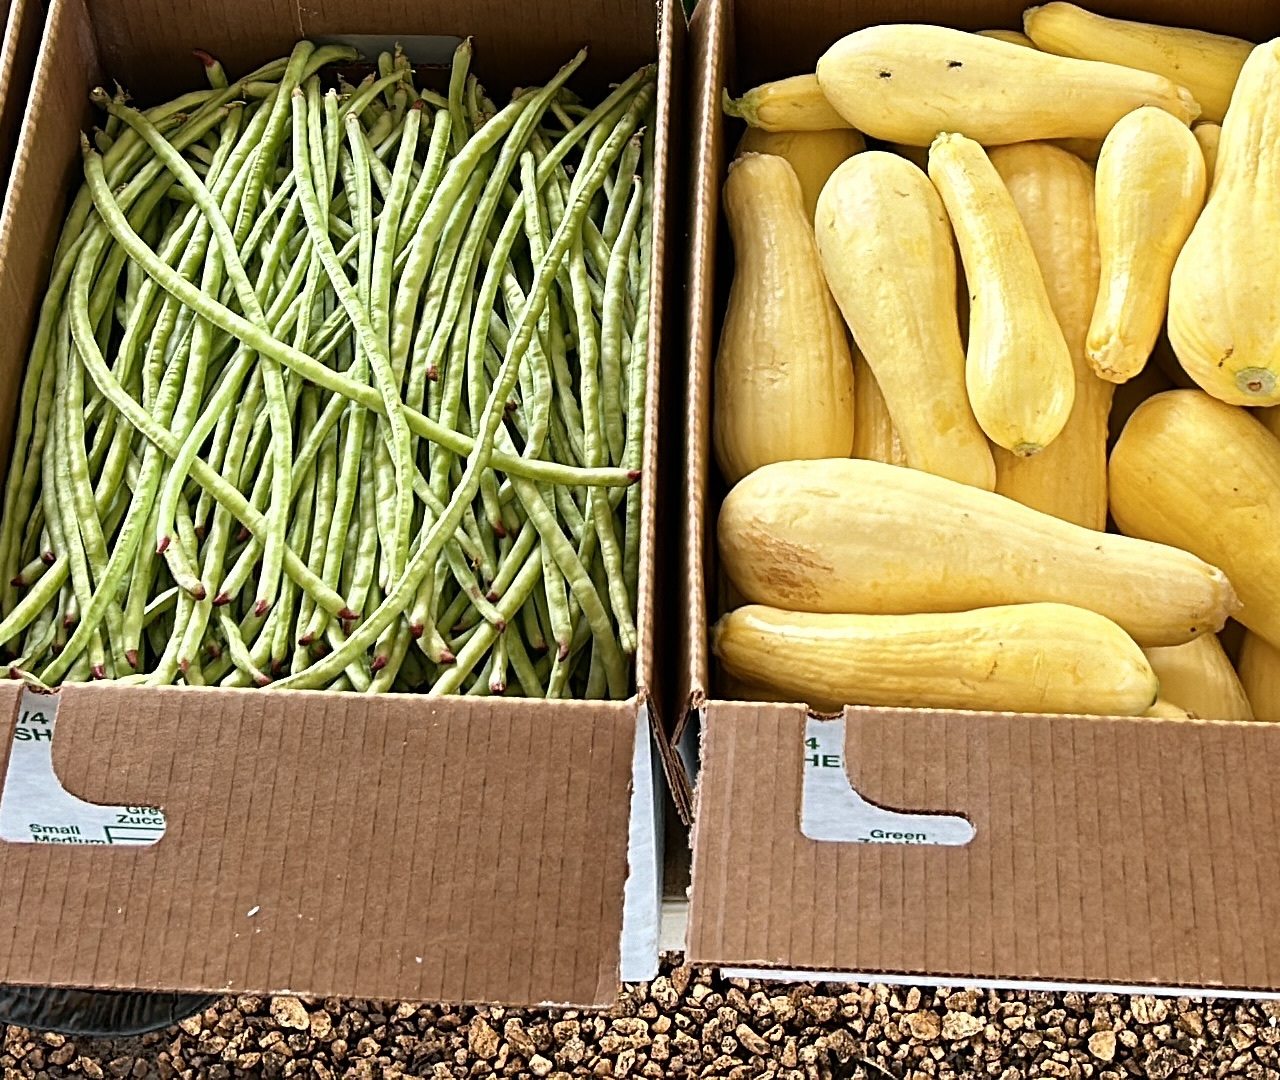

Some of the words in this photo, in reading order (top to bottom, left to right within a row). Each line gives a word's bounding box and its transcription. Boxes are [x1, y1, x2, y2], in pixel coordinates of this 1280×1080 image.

[805, 754, 844, 768] HE
[125, 806, 162, 816] Gre
[116, 814, 166, 825] Zucc
[29, 823, 82, 835] Small
[870, 829, 927, 841] Green
